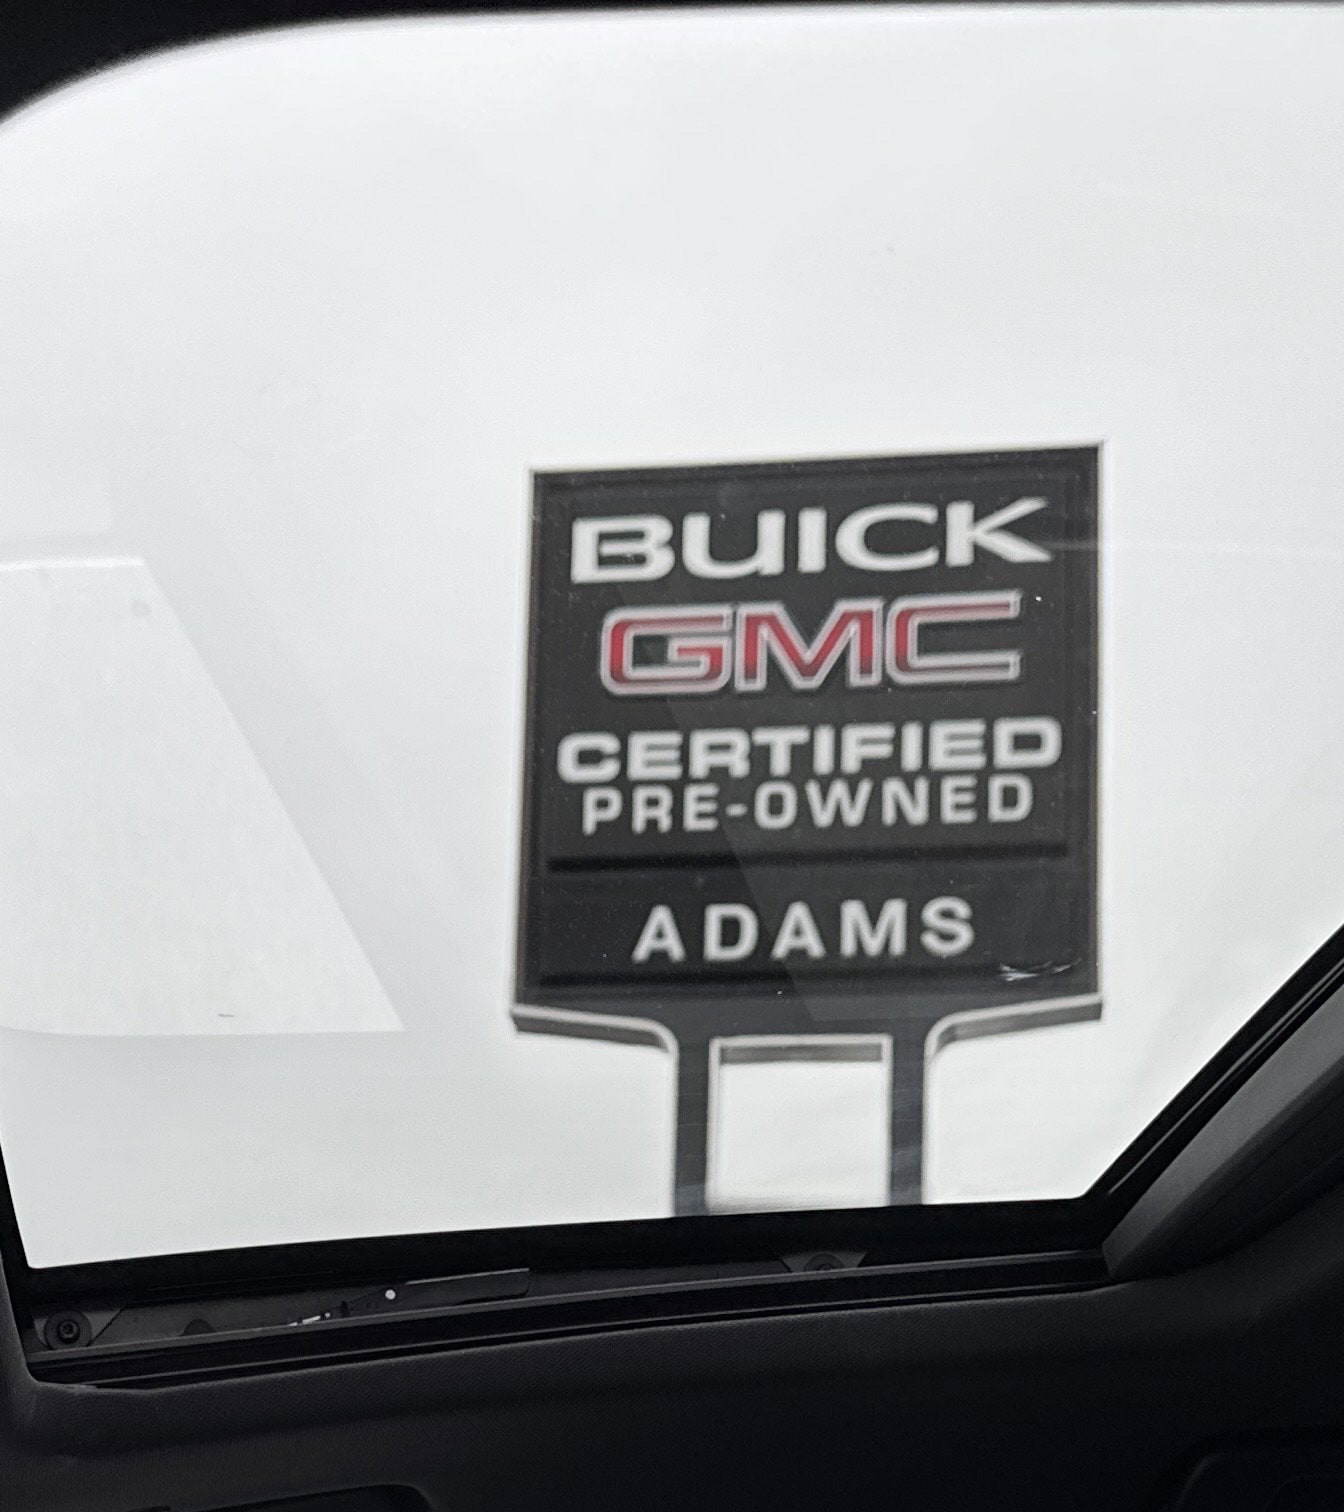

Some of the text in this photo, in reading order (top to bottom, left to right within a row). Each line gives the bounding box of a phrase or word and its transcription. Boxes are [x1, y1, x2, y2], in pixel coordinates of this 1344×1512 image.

[570, 498, 1052, 584] BUICK
[600, 590, 1023, 695] GMC
[557, 716, 1062, 783] CERTIFIED
[582, 773, 1034, 836] PRE-OWNED
[632, 896, 975, 963] ADAMS
